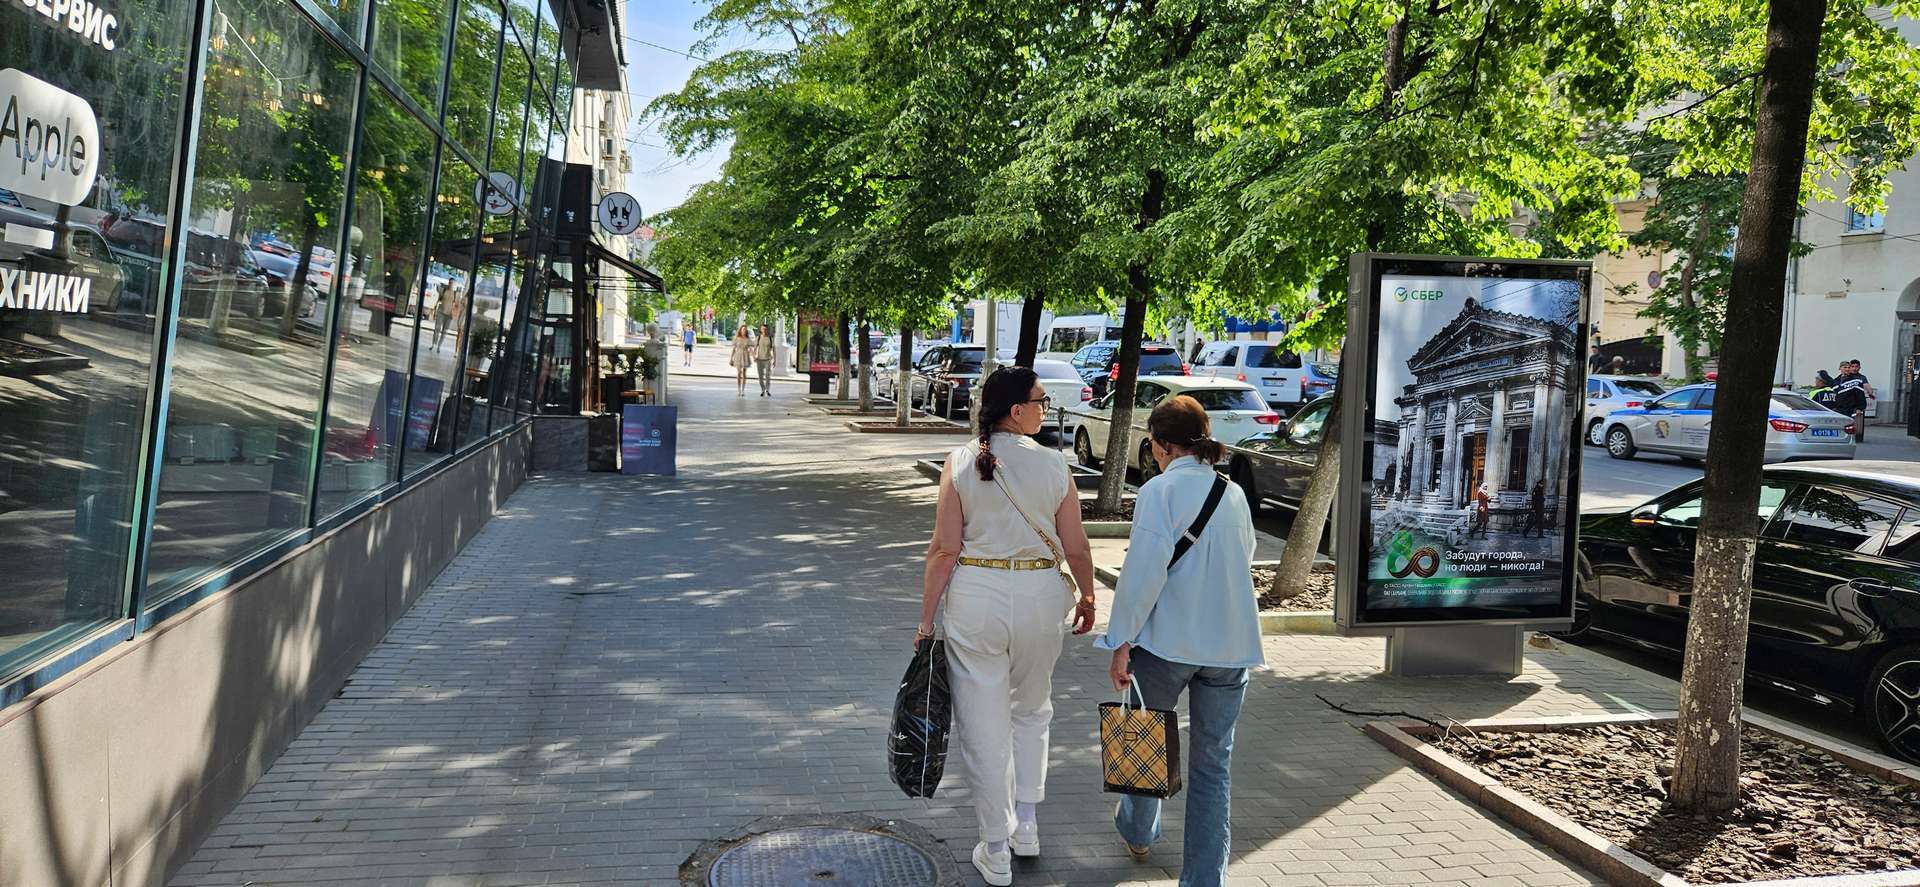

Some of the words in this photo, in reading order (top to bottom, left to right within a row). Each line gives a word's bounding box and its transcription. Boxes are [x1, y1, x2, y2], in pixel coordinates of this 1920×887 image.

[21, 0, 118, 51] РВИС
[0, 94, 86, 182] Apple
[1411, 290, 1444, 301] СБЕР
[1445, 550, 1486, 562] Забудут
[1488, 551, 1526, 561] города,
[1445, 564, 1458, 572] но
[1459, 563, 1487, 573] люди
[1500, 560, 1545, 572] никогда!
